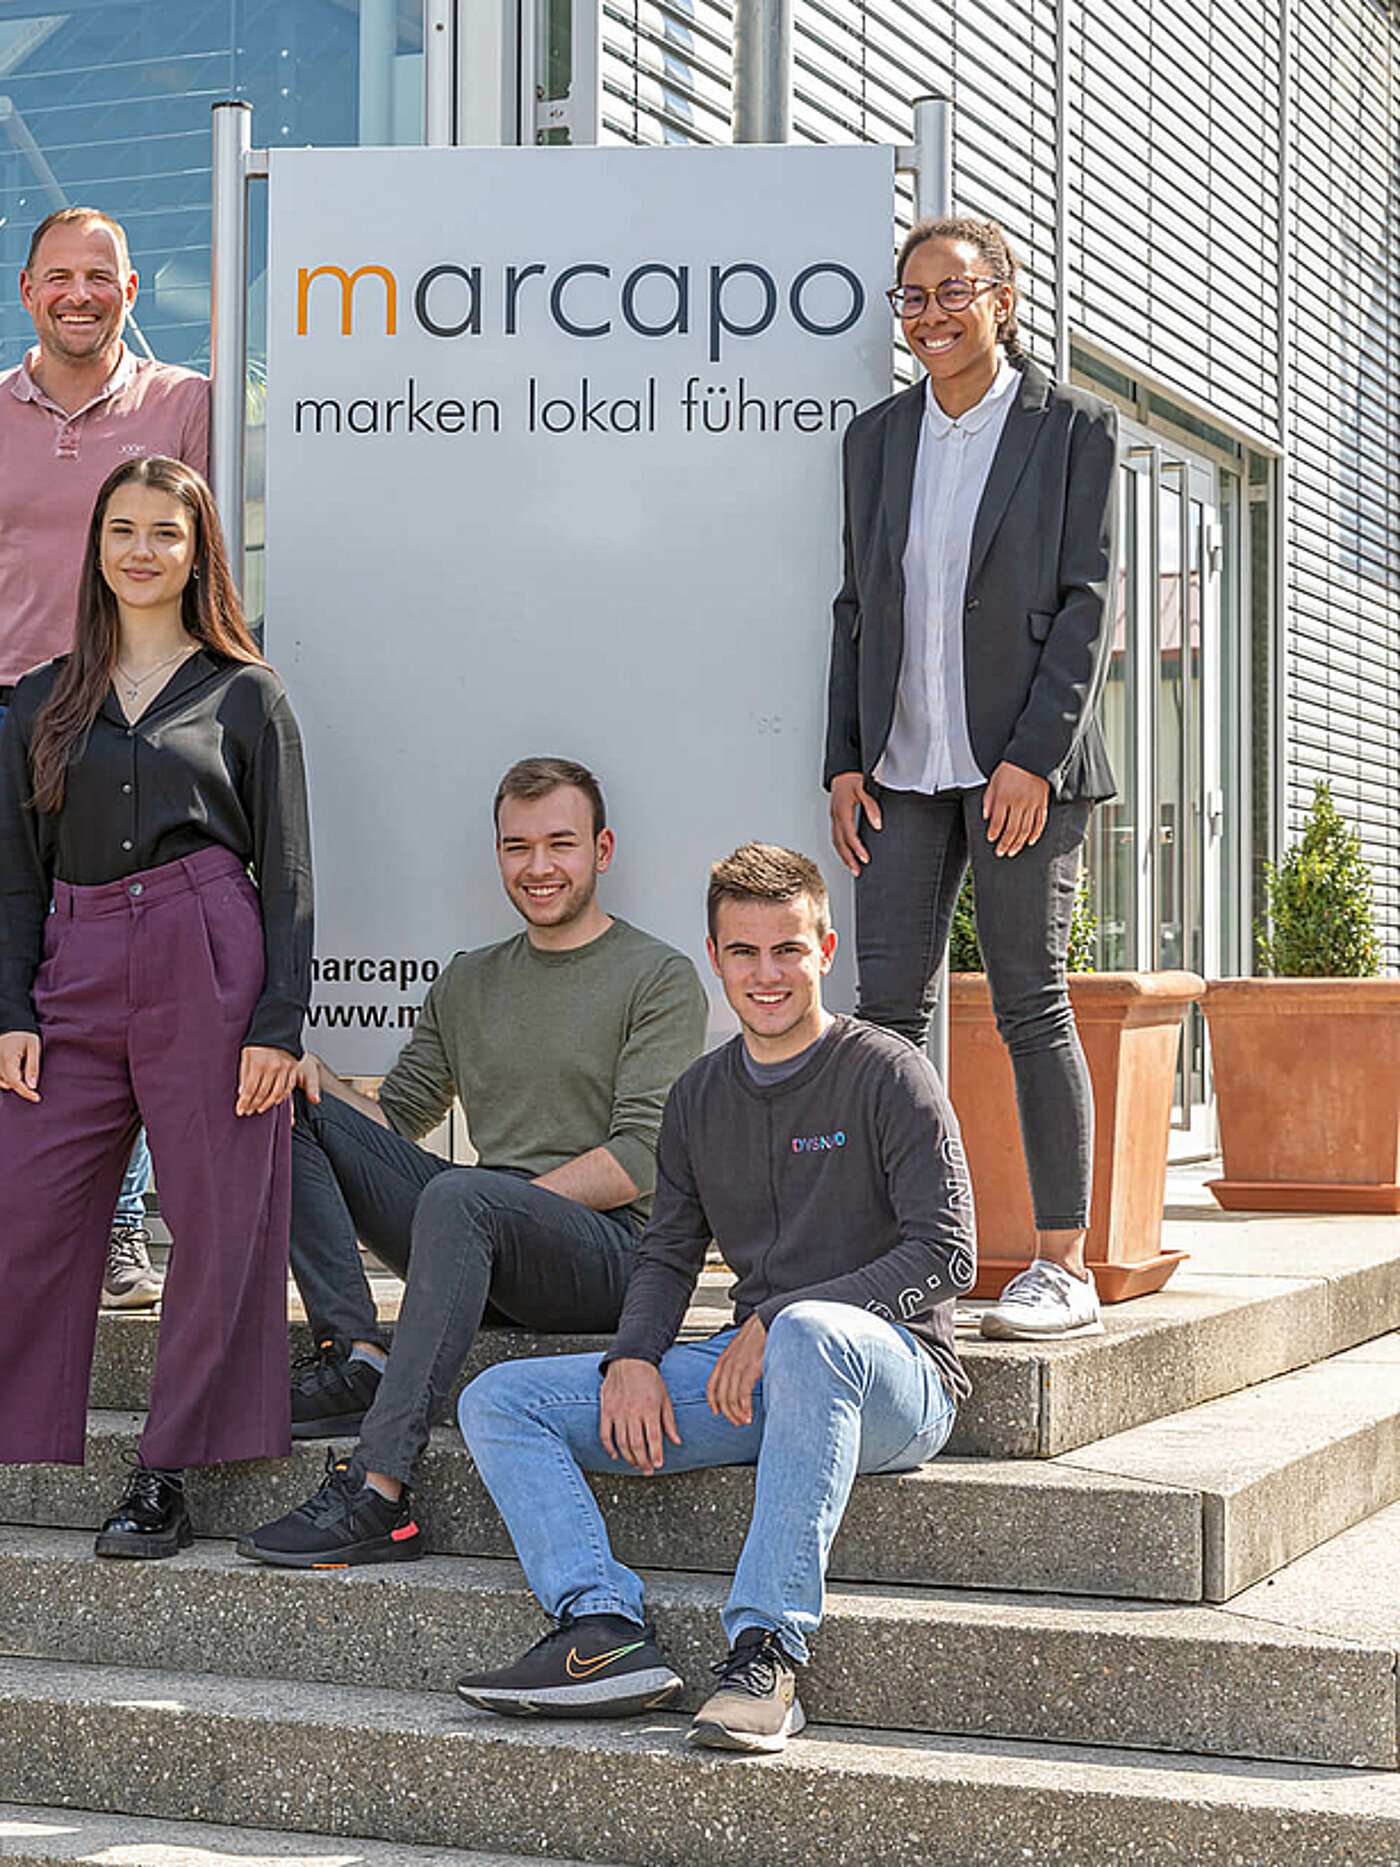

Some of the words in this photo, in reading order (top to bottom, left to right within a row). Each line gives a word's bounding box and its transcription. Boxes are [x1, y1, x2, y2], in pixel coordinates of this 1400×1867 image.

[296, 262, 867, 362] marcapo
[295, 378, 500, 433] marken
[529, 378, 655, 433] lokal
[681, 377, 857, 433] führen
